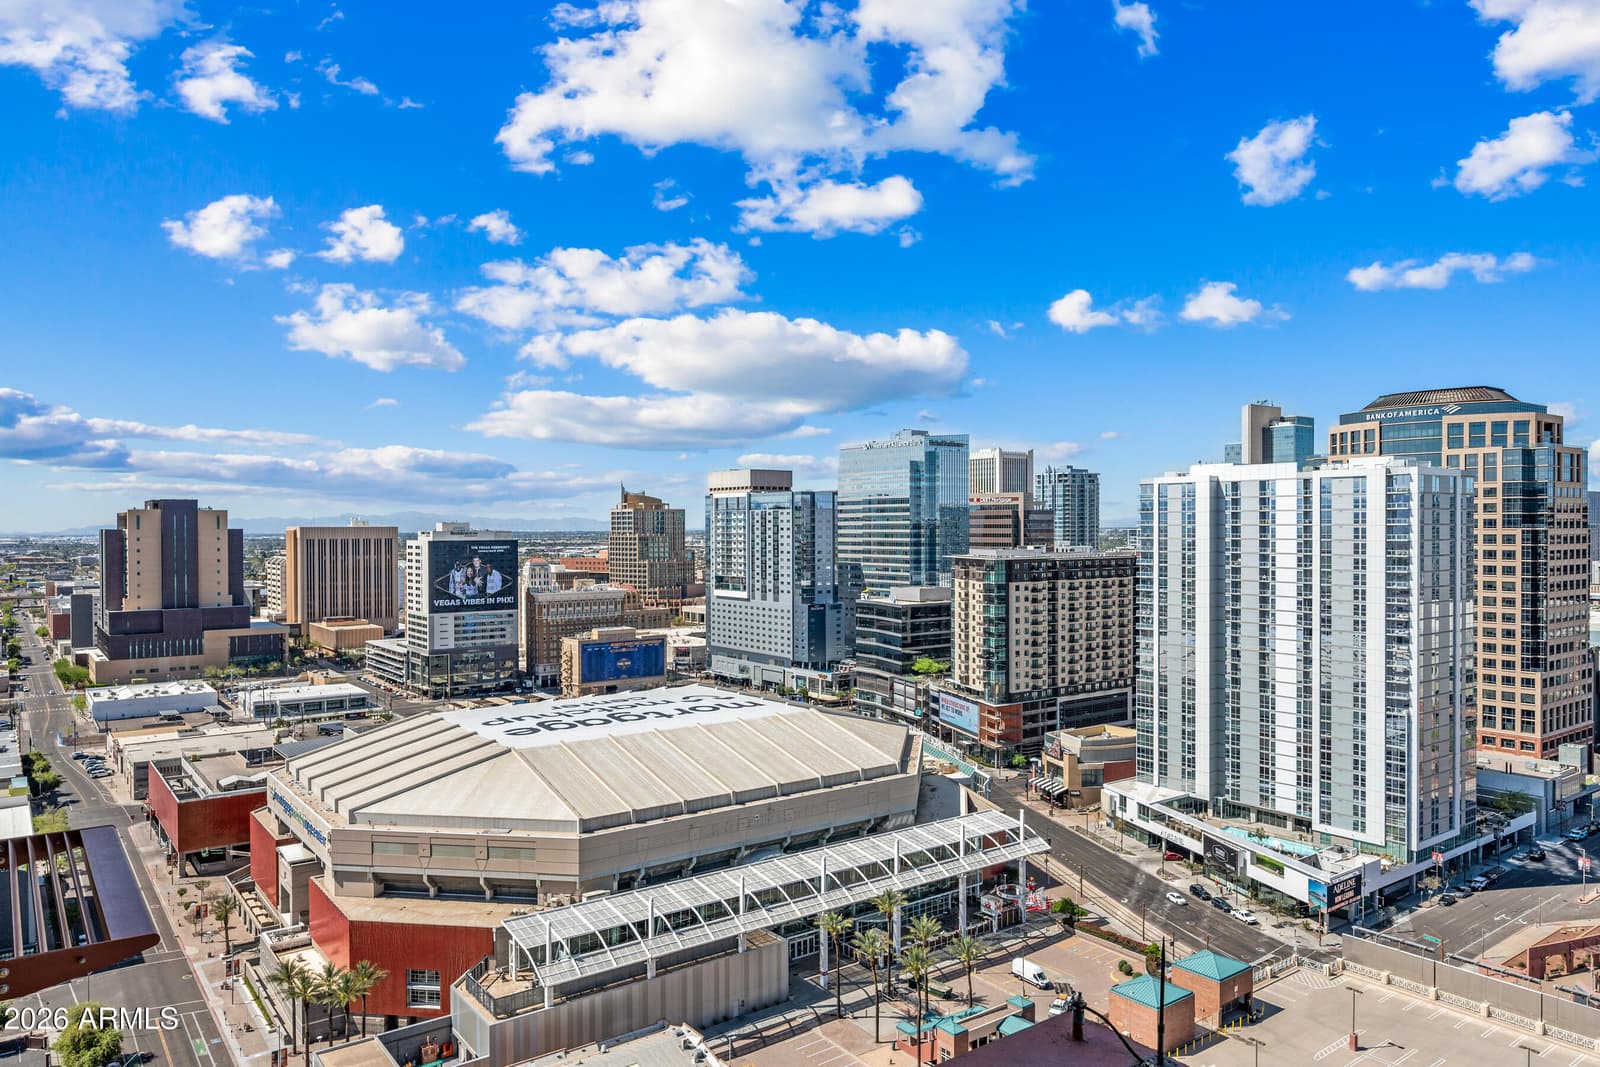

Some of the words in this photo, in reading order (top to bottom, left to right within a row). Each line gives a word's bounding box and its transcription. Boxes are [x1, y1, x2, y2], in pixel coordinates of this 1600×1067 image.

[1399, 408, 1440, 417] AMERICA
[861, 592, 869, 600] EY
[481, 699, 675, 727] matchup
[503, 700, 765, 736] mortgage
[1333, 878, 1356, 894] ADELINE
